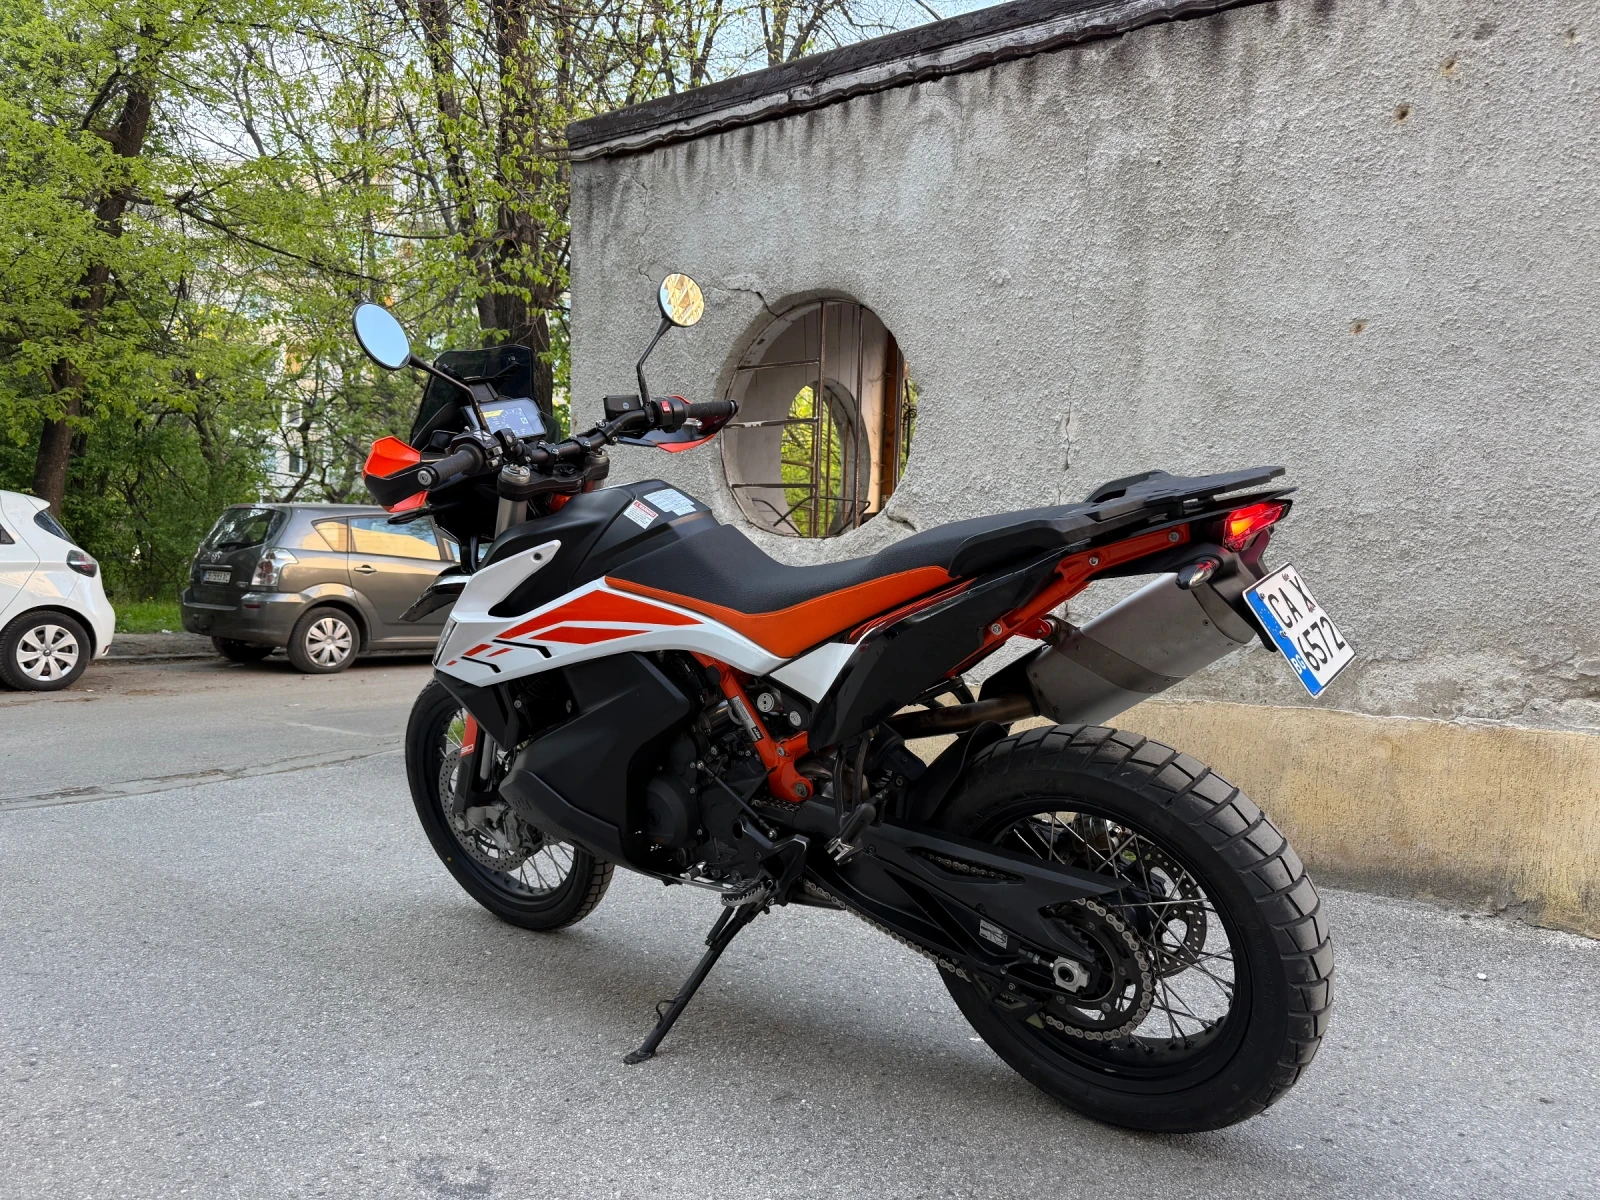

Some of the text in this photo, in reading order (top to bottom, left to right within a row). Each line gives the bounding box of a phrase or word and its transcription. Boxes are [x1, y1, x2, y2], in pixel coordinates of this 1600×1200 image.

[1267, 575, 1317, 629] CA X
[1290, 654, 1307, 675] BG
[1297, 616, 1346, 672] 6572
